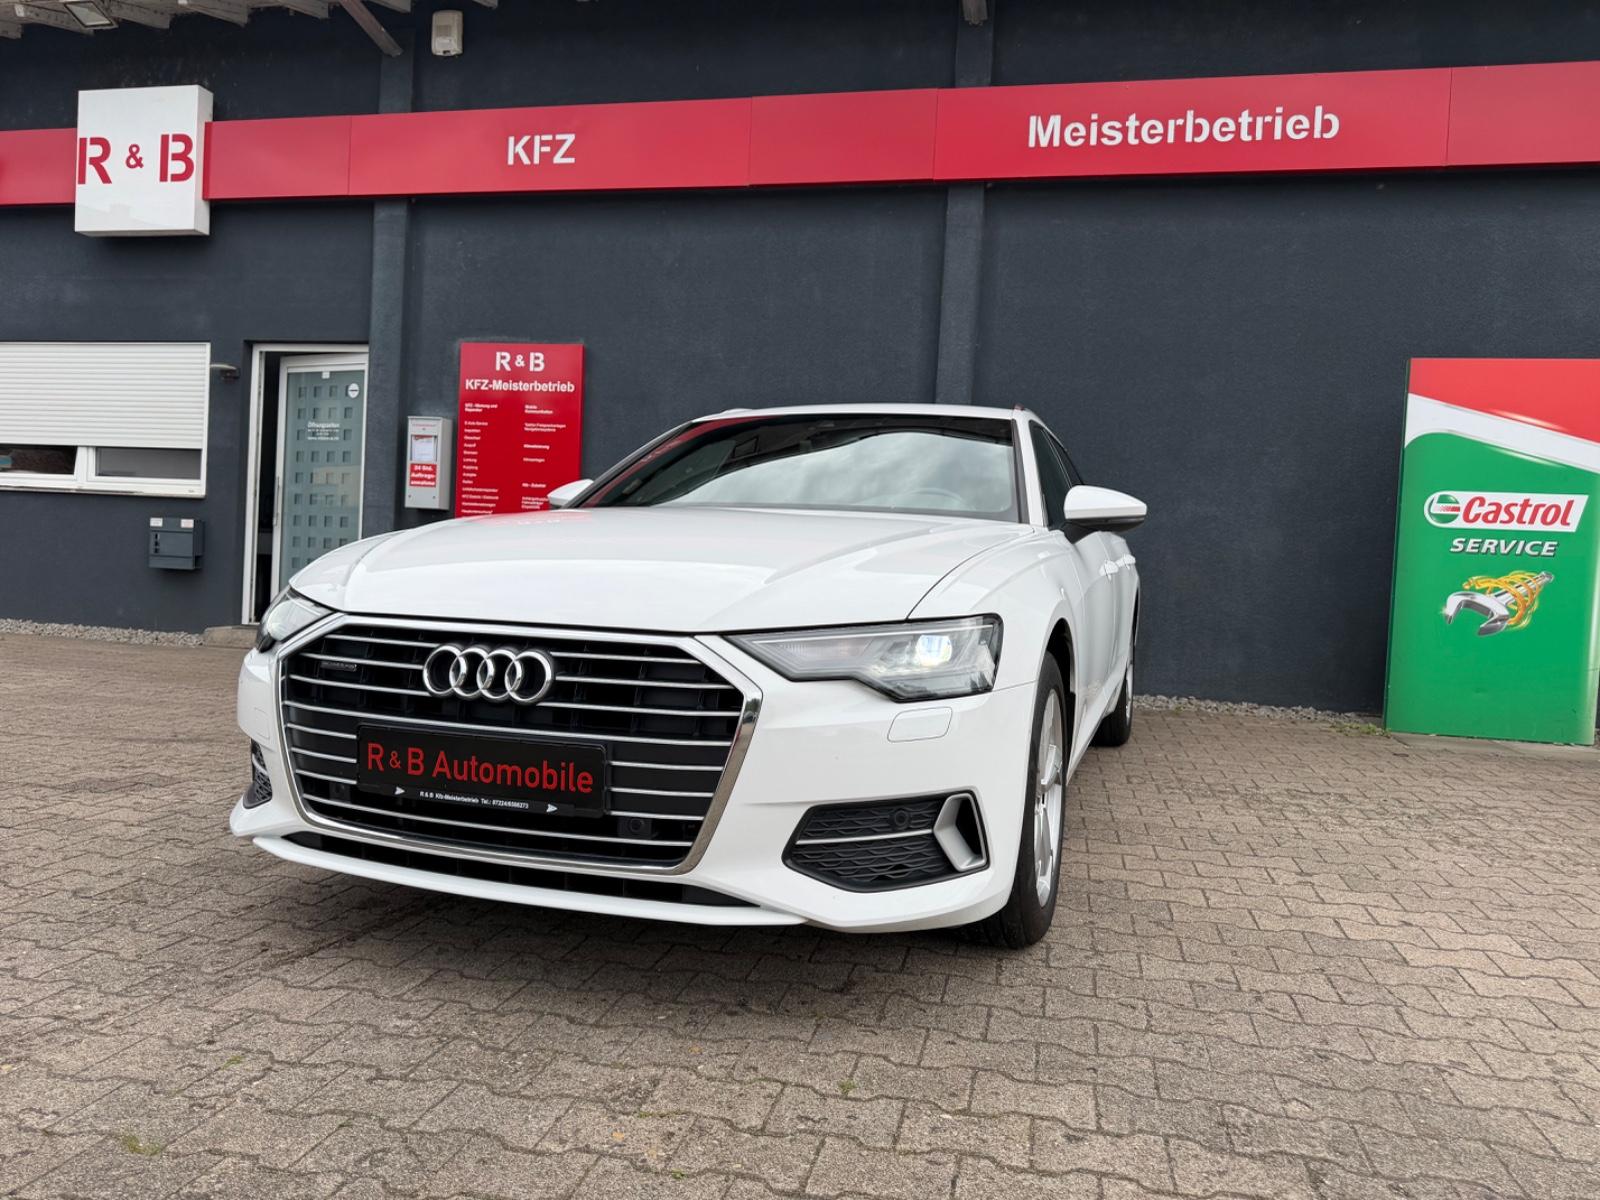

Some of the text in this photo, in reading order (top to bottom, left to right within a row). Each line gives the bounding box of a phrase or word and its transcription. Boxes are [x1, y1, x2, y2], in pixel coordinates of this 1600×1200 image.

[1028, 105, 1340, 148] Meisterbetrieb
[77, 133, 195, 185] R & B
[507, 133, 576, 165] KFZ
[495, 351, 545, 372] R & B
[465, 379, 575, 393] KFZ-Meisterbetrieb
[1462, 496, 1575, 526] Castrol
[1450, 537, 1558, 557] SERVICE
[366, 742, 594, 793] R & B Automobile
